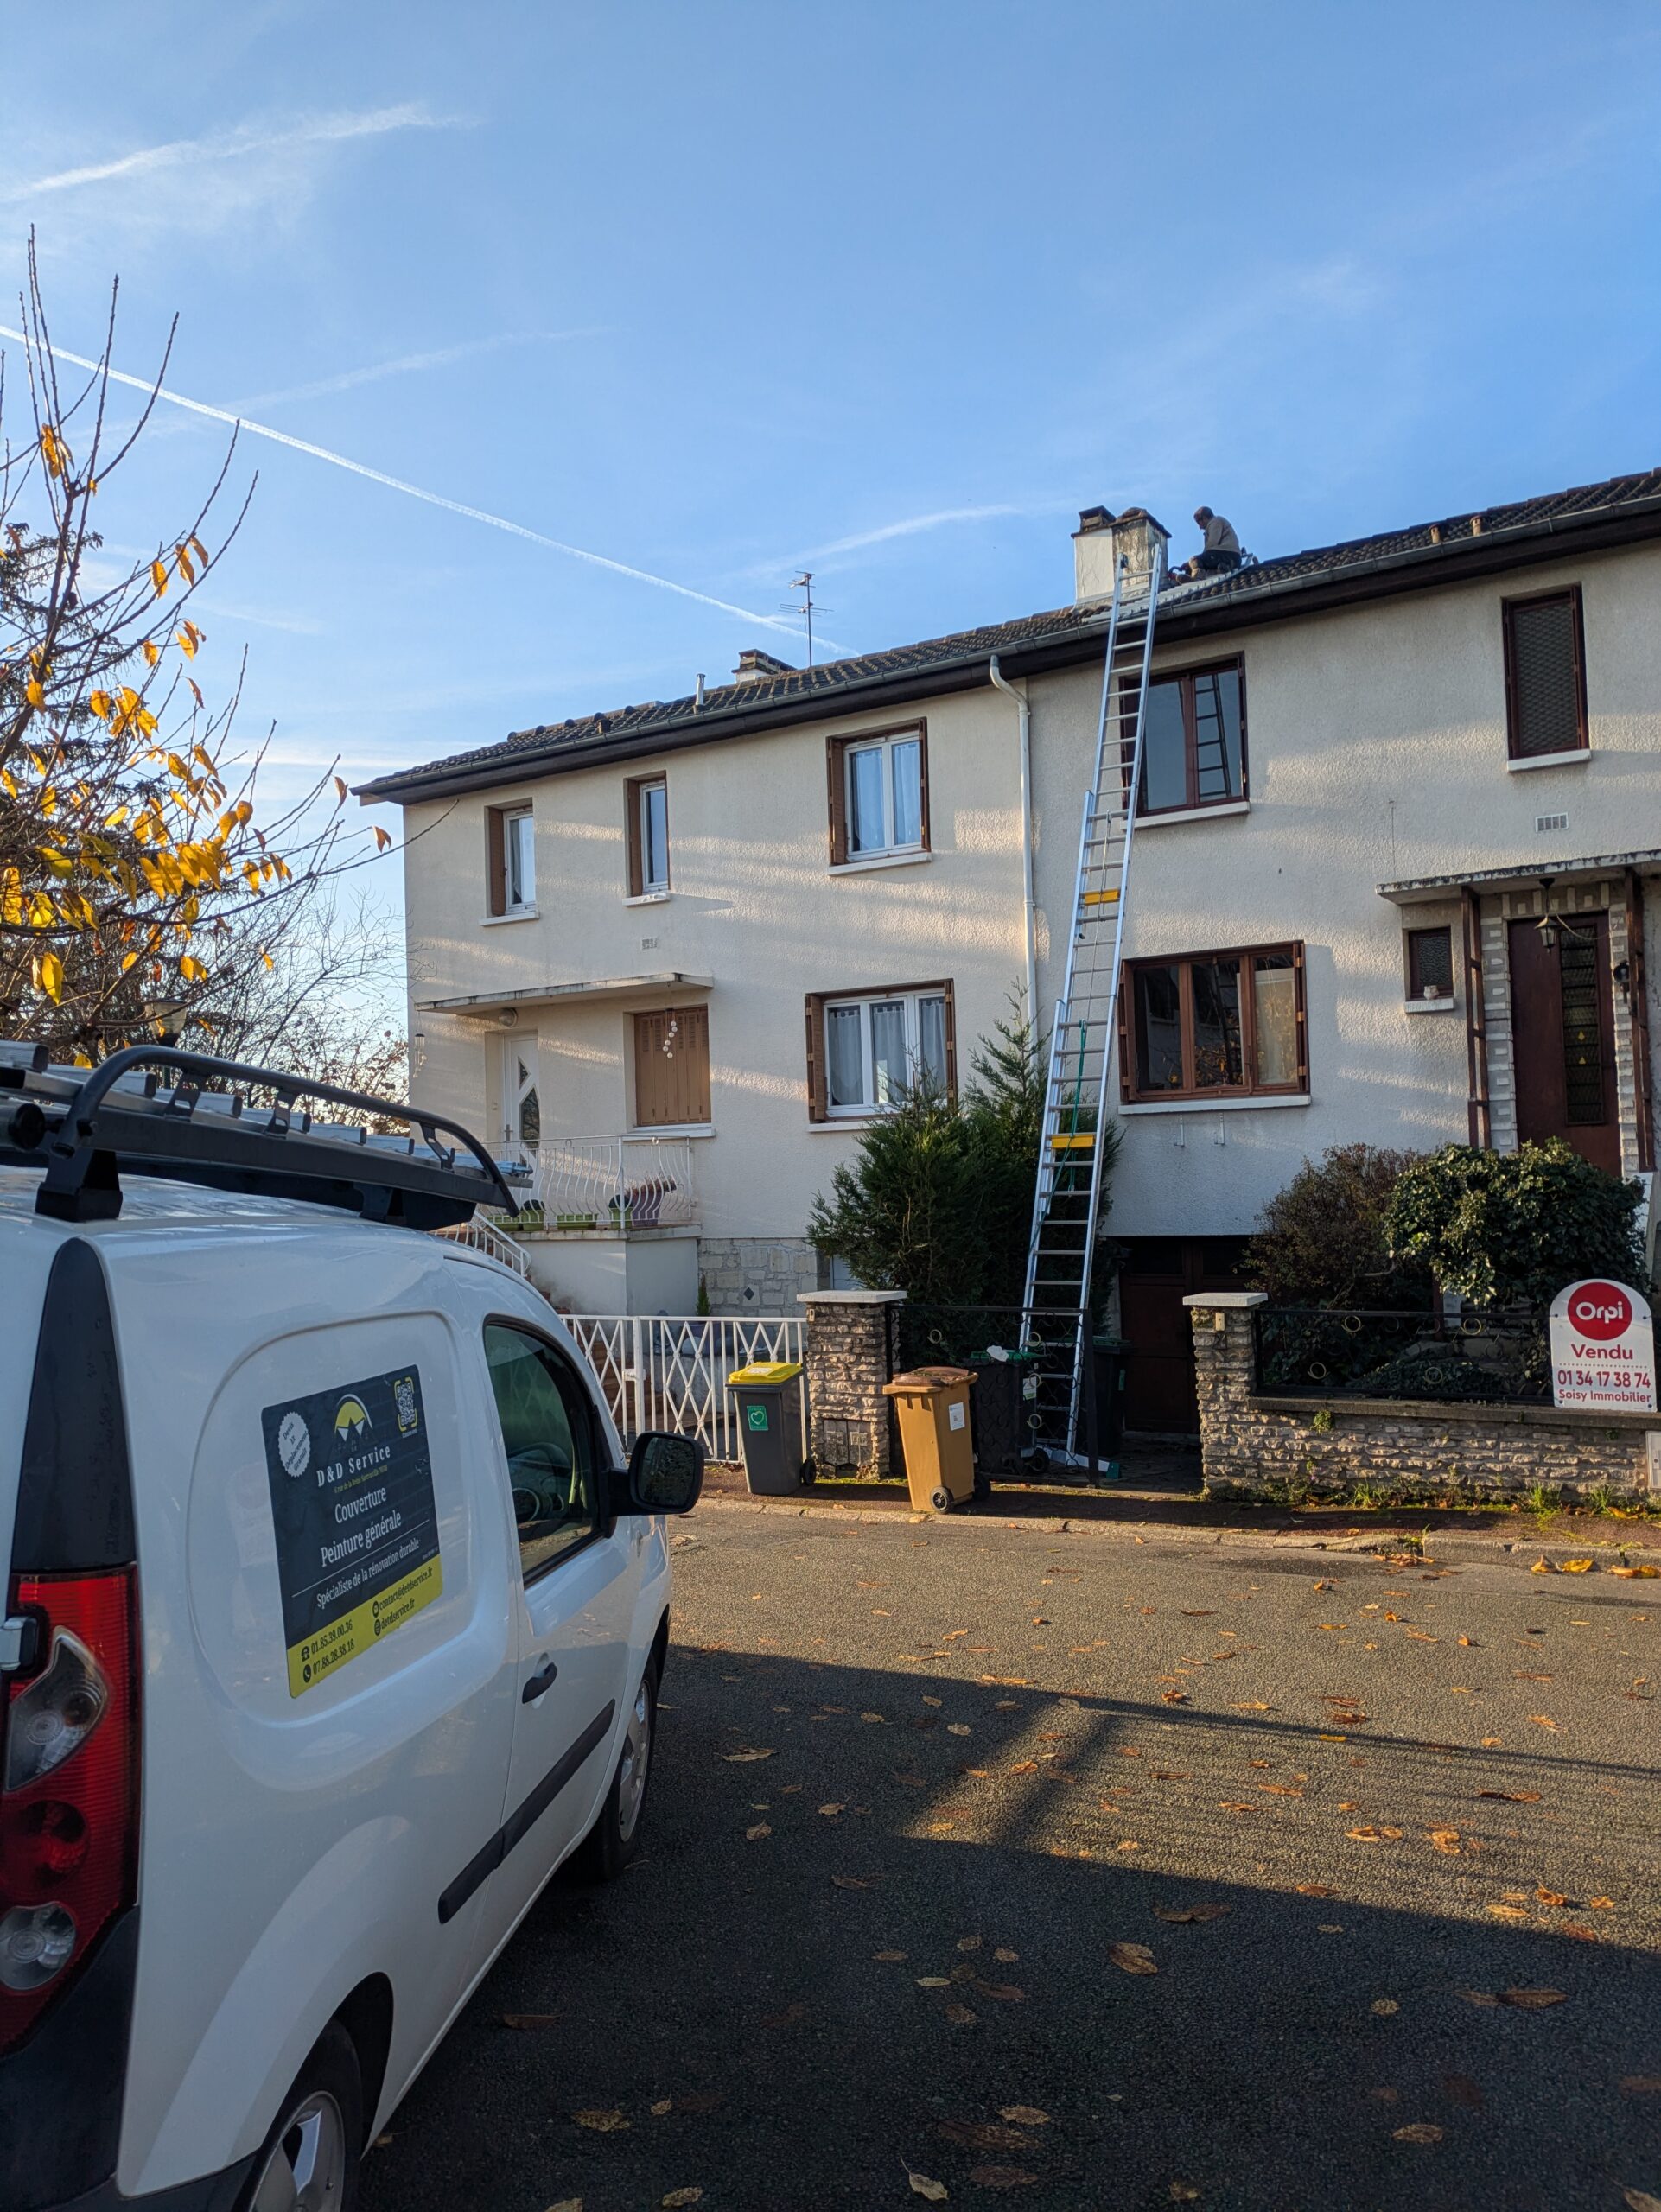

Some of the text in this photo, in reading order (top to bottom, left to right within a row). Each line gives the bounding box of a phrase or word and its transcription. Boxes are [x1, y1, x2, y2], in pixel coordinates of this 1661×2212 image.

[1576, 1300, 1624, 1324] Orpi
[1571, 1344, 1633, 1360] Vendu
[1557, 1370, 1651, 1389] 01 34 17 38 74
[1559, 1389, 1651, 1403] Soisy Immobilier
[315, 1462, 343, 1487] D&D
[348, 1446, 391, 1474] Service
[334, 1487, 387, 1524] Couverture
[320, 1510, 402, 1568] Peinture générale
[316, 1579, 353, 1610] Spécialiste
[353, 1572, 361, 1587] de
[360, 1567, 368, 1582] la
[368, 1550, 399, 1579] rénovation
[399, 1537, 420, 1559] durable
[380, 1598, 416, 1630] detdservice.fr
[310, 1618, 353, 1656] 01.85.39.00.36
